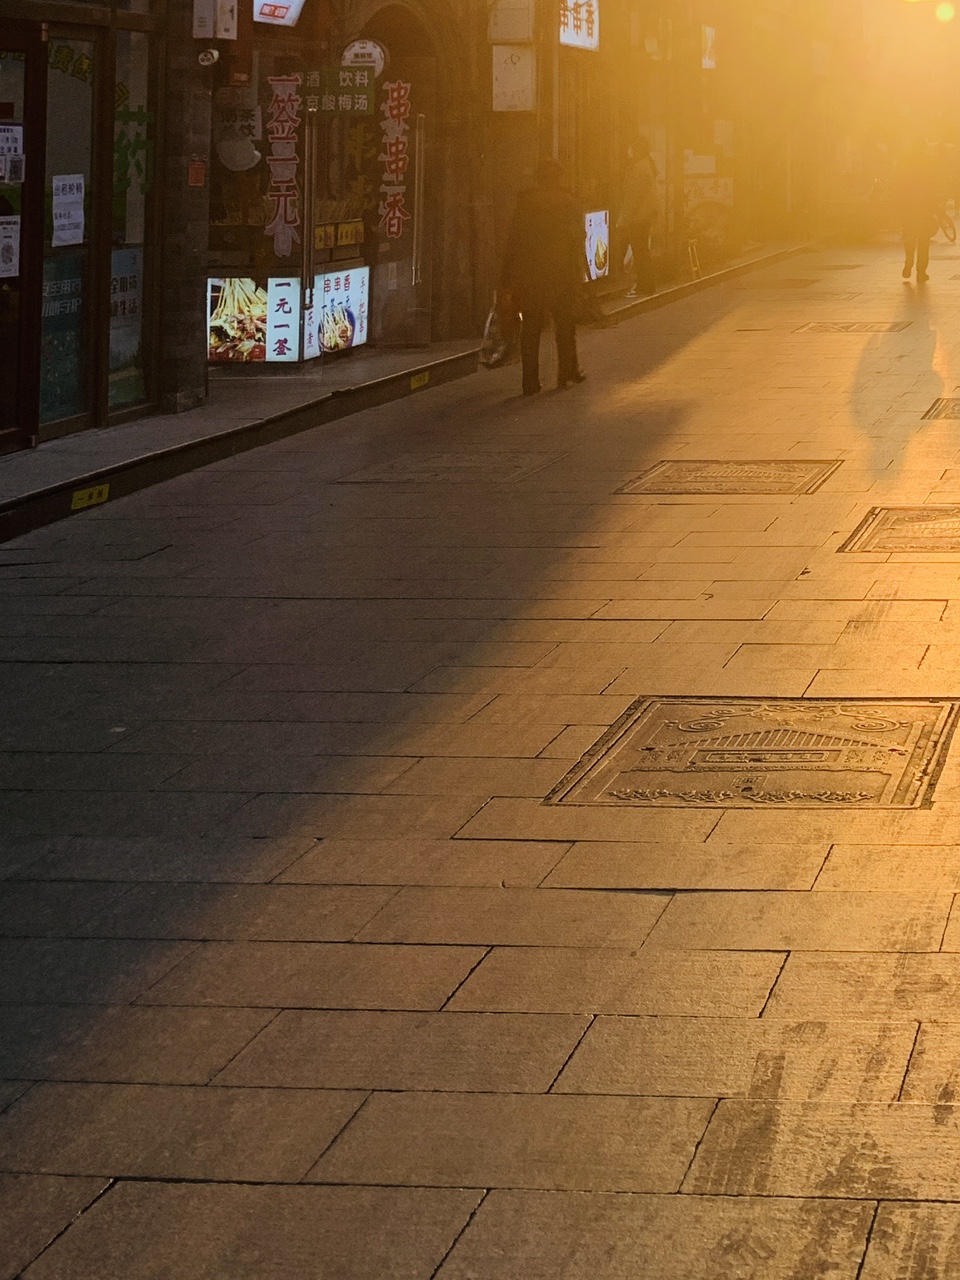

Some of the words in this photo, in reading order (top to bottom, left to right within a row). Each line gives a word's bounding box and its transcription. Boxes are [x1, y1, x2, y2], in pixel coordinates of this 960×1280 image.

[338, 70, 369, 88] 饮料
[265, 74, 303, 229] 一签一元
[379, 80, 411, 239] 串串香
[273, 281, 292, 357] 一元一签
[324, 274, 351, 295] 串串香
